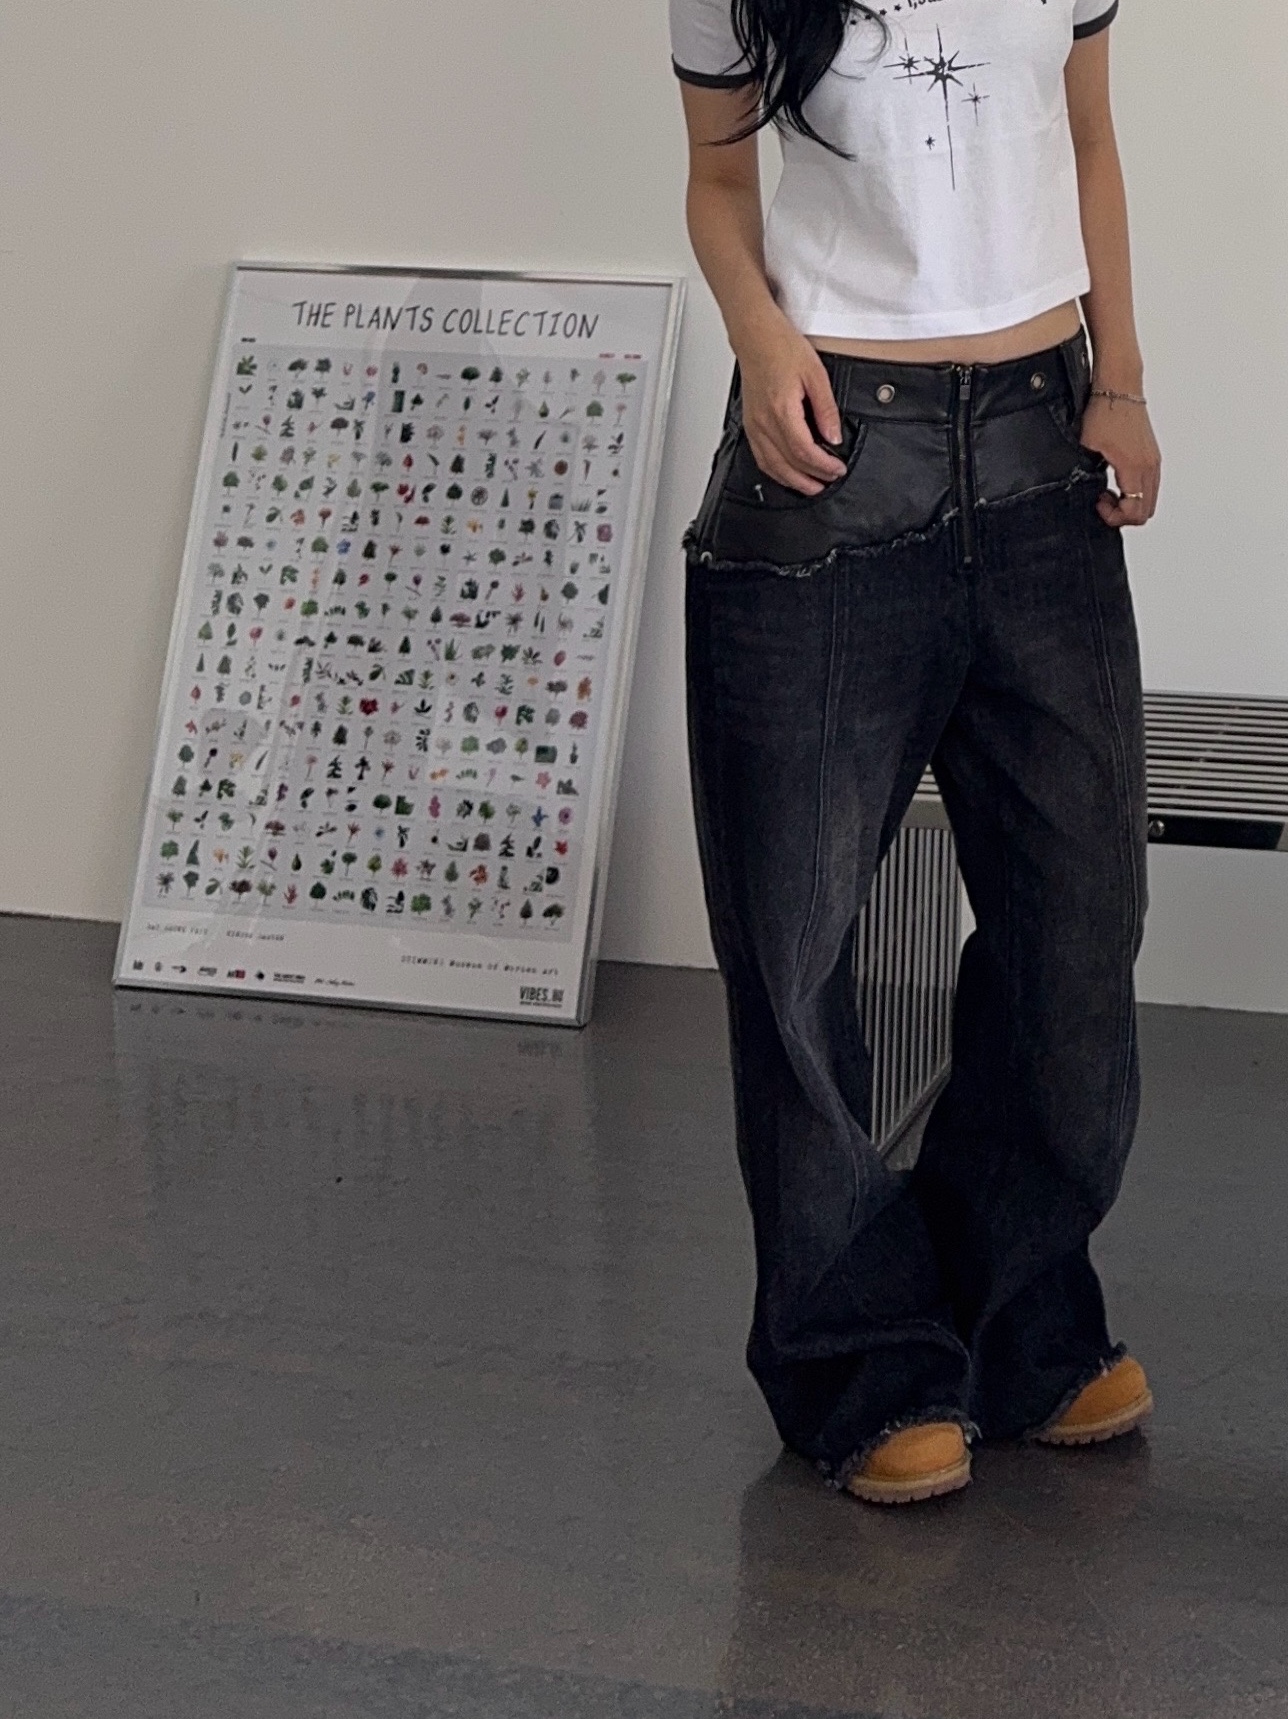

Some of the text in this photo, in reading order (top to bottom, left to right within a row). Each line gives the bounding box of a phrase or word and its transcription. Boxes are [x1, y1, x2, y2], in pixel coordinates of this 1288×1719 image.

[292, 300, 599, 339] THE PLANTS COLLECTION
